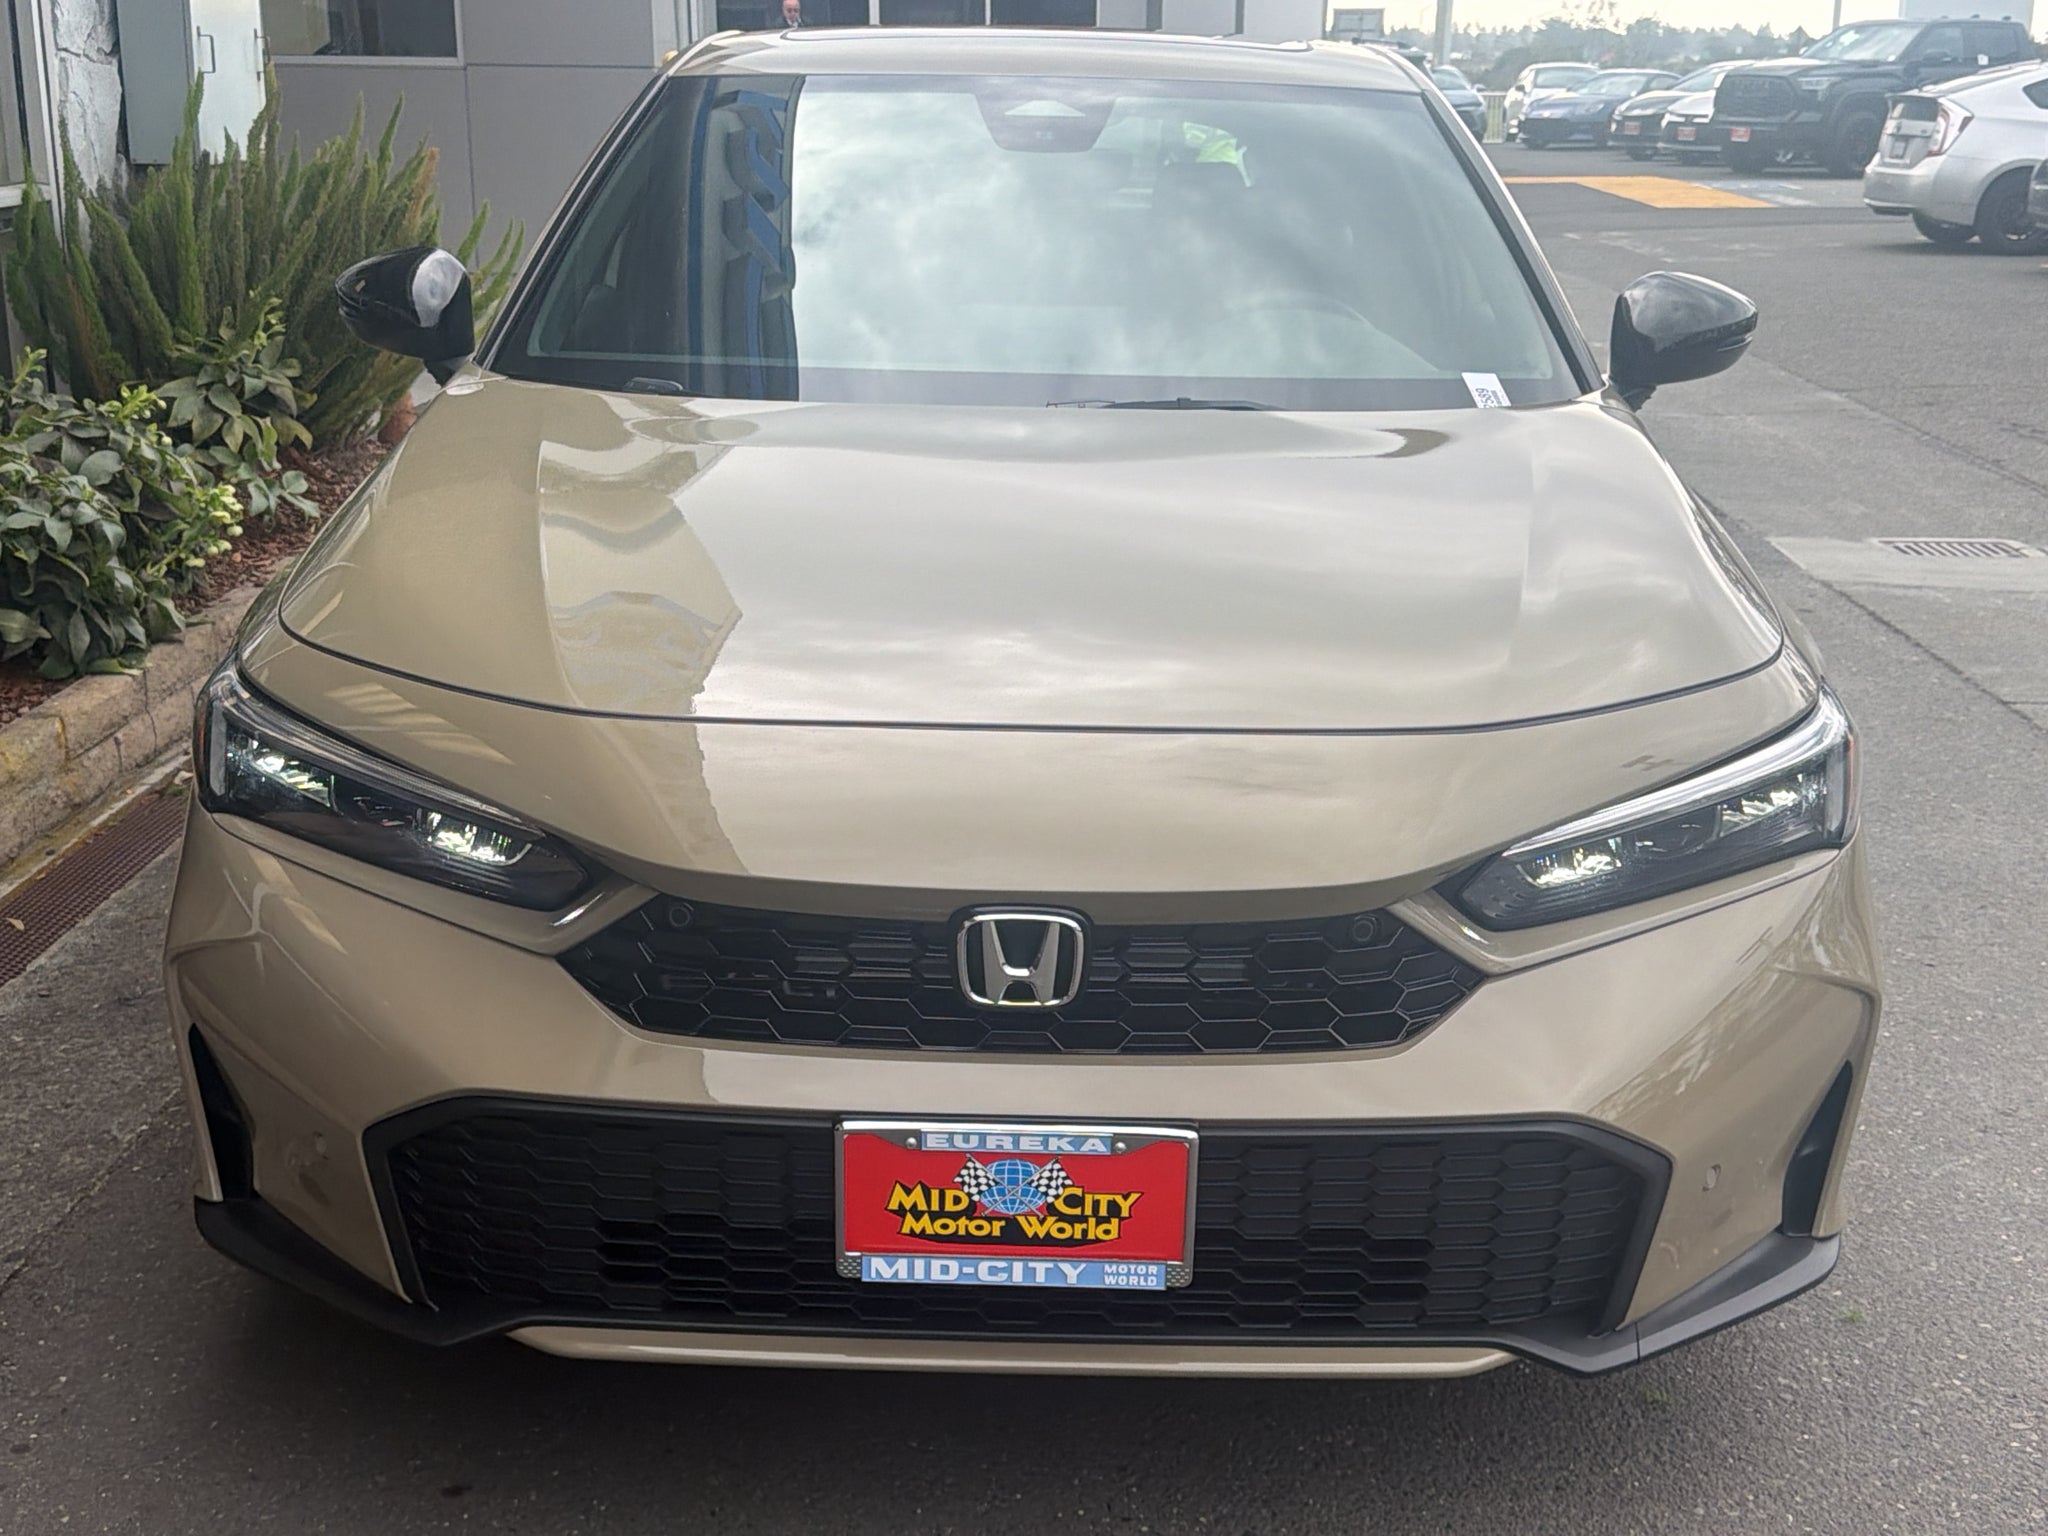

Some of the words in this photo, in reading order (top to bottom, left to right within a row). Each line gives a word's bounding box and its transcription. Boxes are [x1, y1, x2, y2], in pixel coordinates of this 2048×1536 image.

[925, 1133, 1110, 1152] EUREKA
[900, 1216, 1006, 1237] Motor
[1015, 1216, 1121, 1240] World
[870, 1258, 1088, 1285] MID-CITY
[1103, 1265, 1158, 1276] MOTOR
[1103, 1275, 1158, 1287] WORLD
